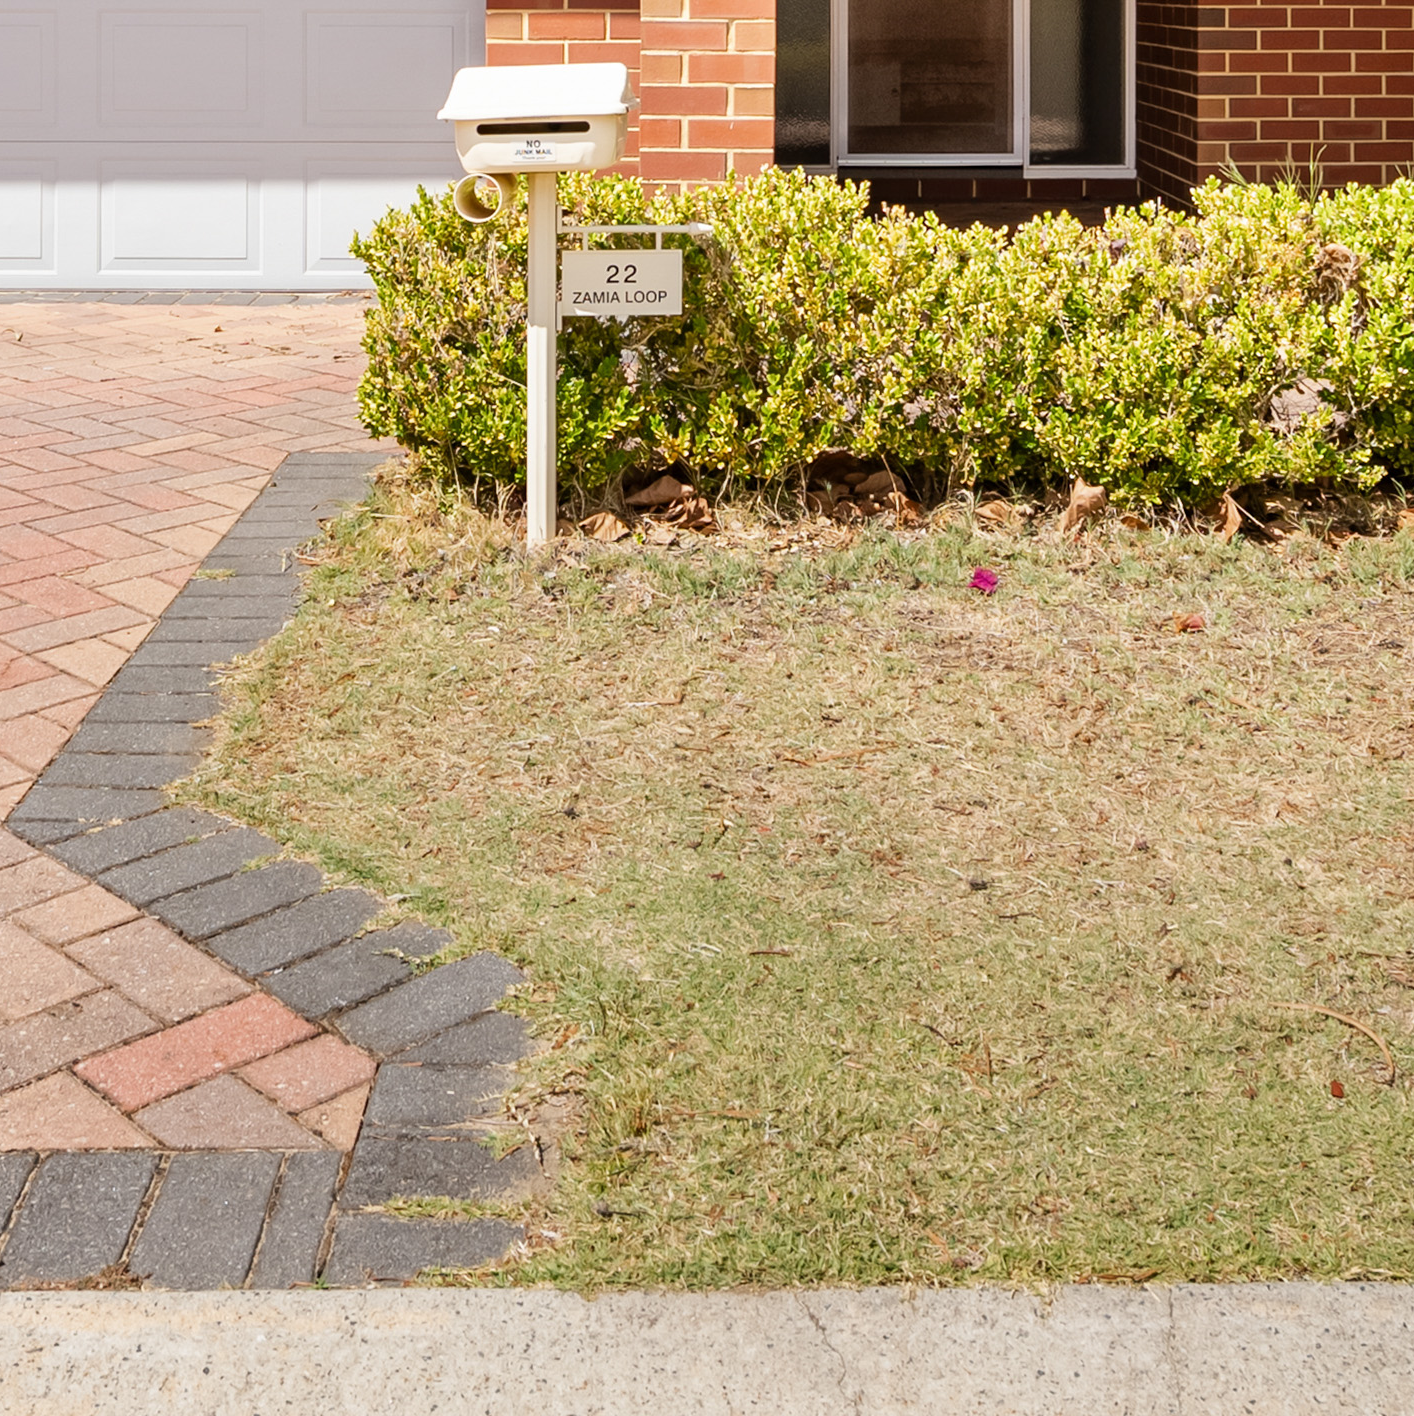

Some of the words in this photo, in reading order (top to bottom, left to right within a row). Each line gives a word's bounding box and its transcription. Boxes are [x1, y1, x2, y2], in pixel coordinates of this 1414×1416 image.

[526, 139, 541, 149] NO
[605, 264, 637, 284] 22
[572, 292, 621, 305] ZAMIA
[625, 290, 668, 304] LOOP
